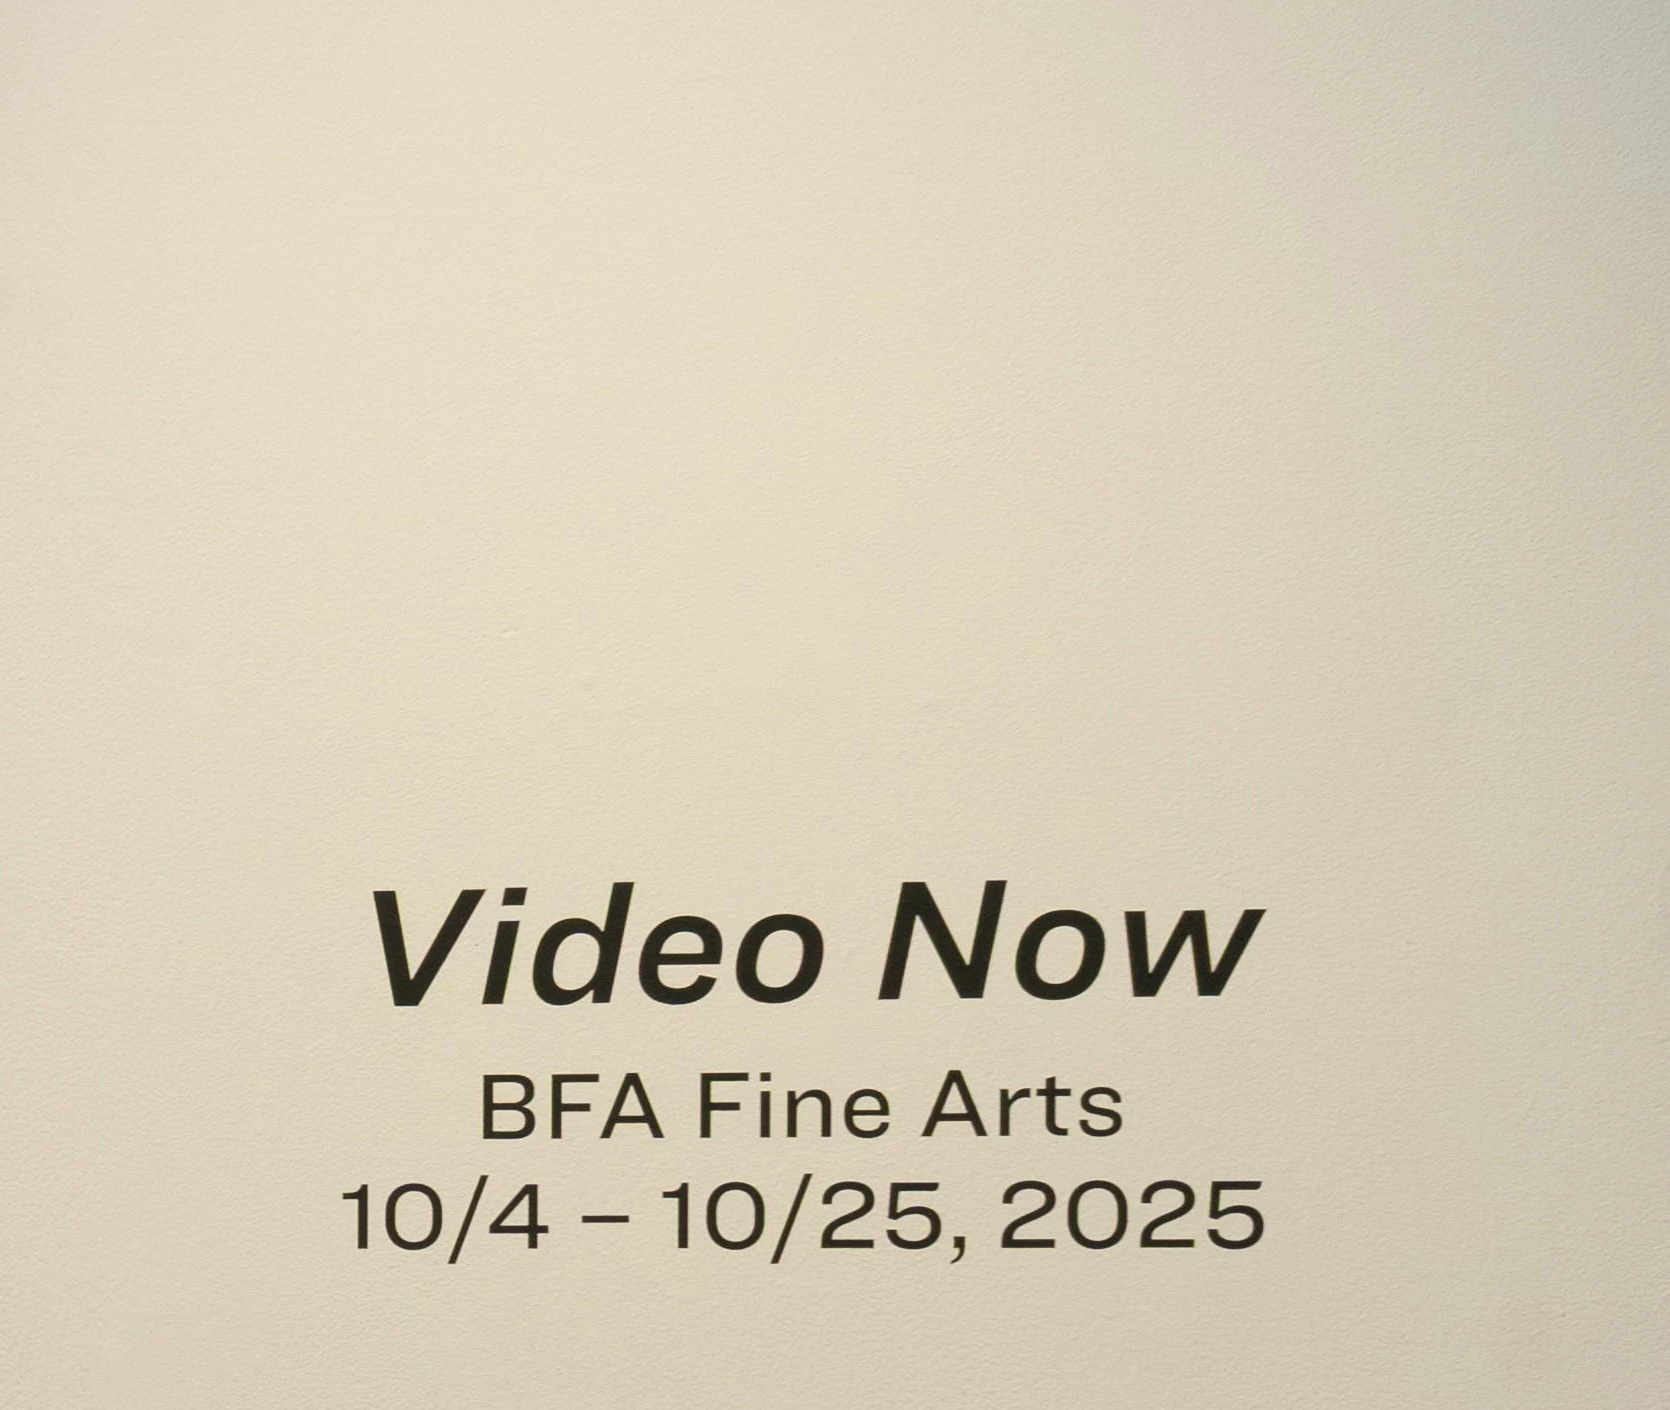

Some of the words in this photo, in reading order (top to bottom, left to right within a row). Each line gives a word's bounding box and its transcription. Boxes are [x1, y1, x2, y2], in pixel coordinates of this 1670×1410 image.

[373, 881, 824, 1007] Video
[878, 879, 1267, 1001] Now
[482, 1072, 664, 1140] BFA
[700, 1072, 890, 1139] Fine
[921, 1069, 1122, 1137] Arts
[342, 1174, 549, 1265] 10/4
[662, 1173, 966, 1265] 10/25,
[1001, 1179, 1264, 1250] 2025
